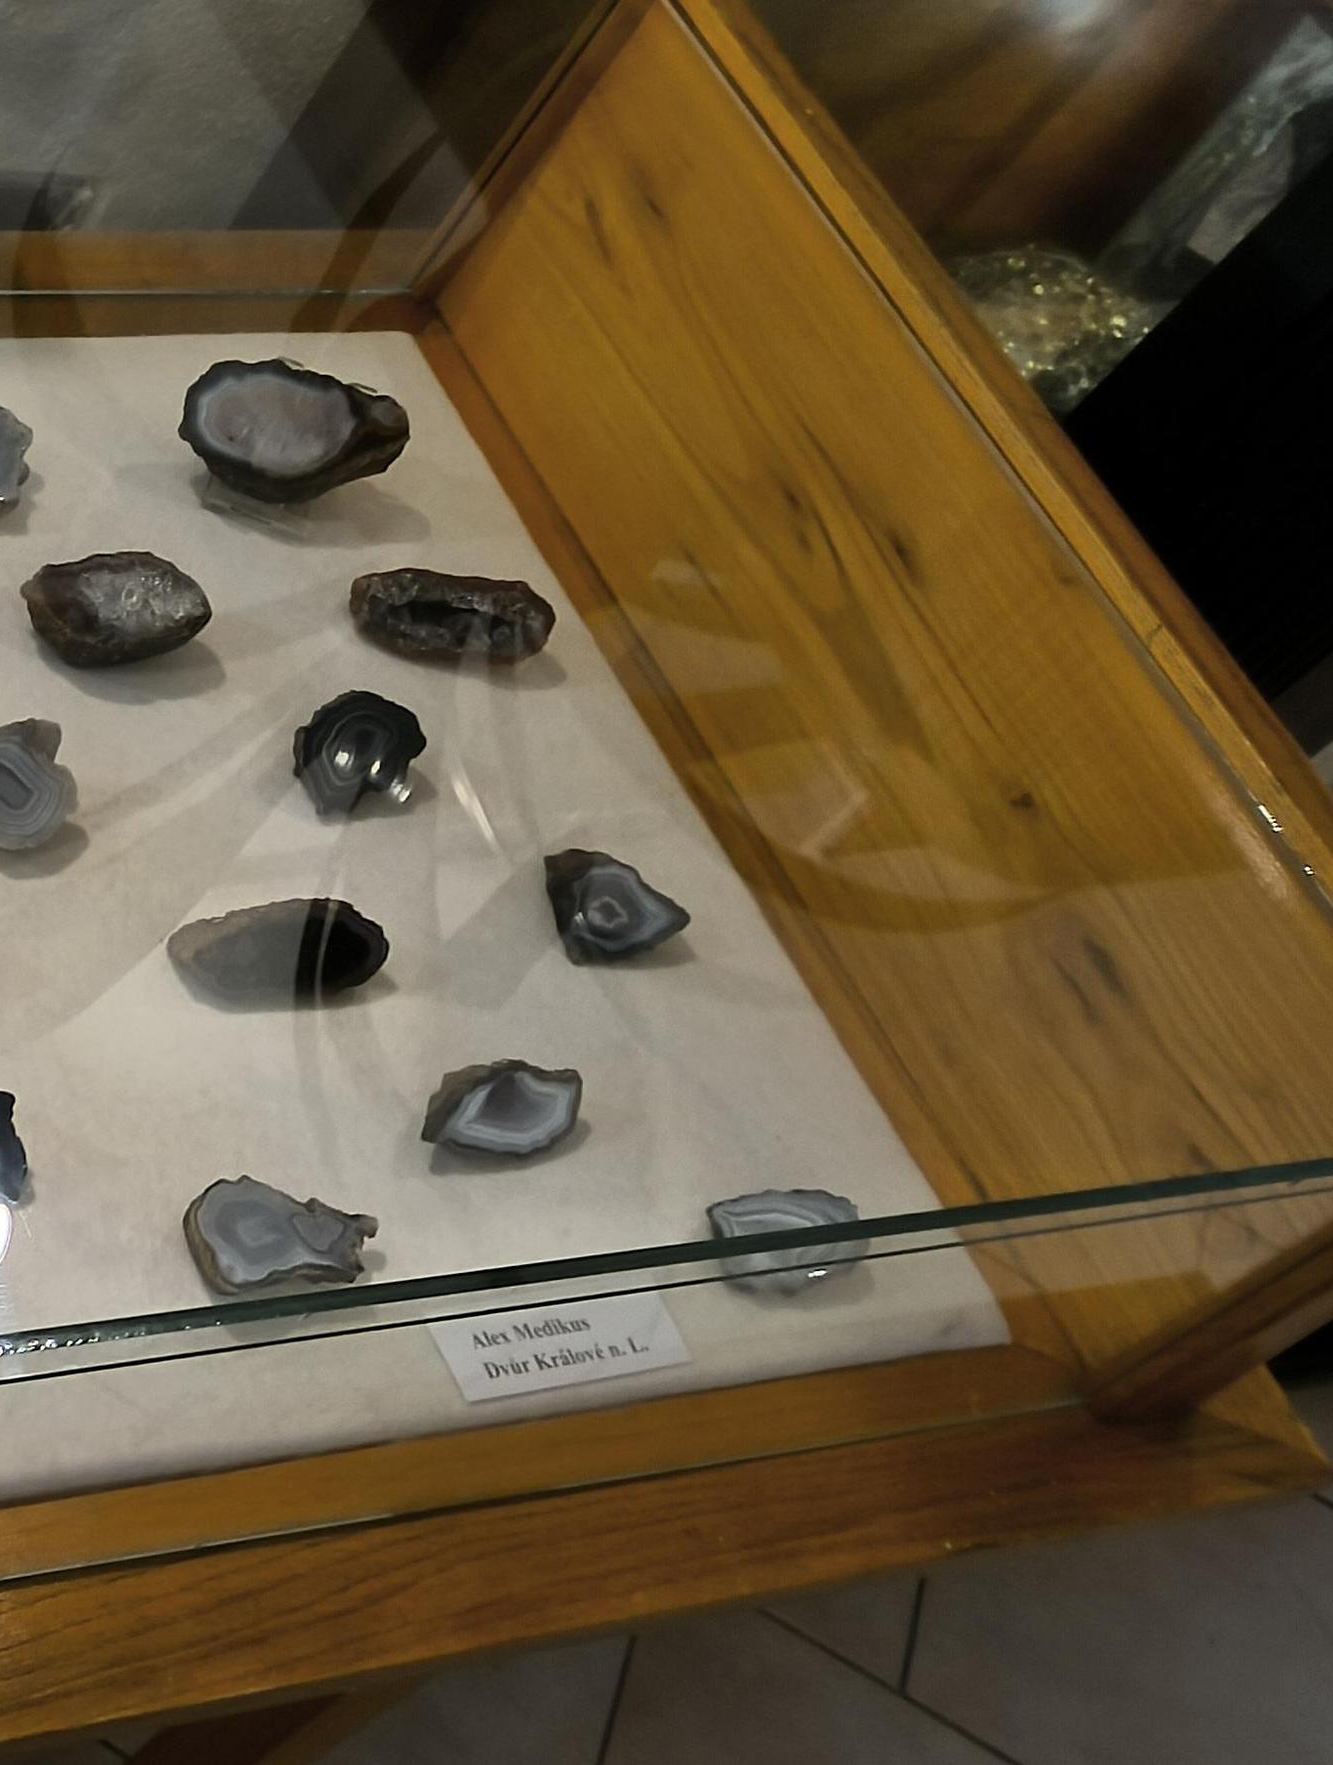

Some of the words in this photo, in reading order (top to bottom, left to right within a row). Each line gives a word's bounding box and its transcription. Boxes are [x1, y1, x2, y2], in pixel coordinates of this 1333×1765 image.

[472, 1332, 511, 1350] Alex
[513, 1318, 591, 1342] Medikus
[484, 1357, 530, 1379] Dvůr
[535, 1342, 605, 1371] Králové
[610, 1343, 626, 1357] n.
[629, 1337, 649, 1354] L.
